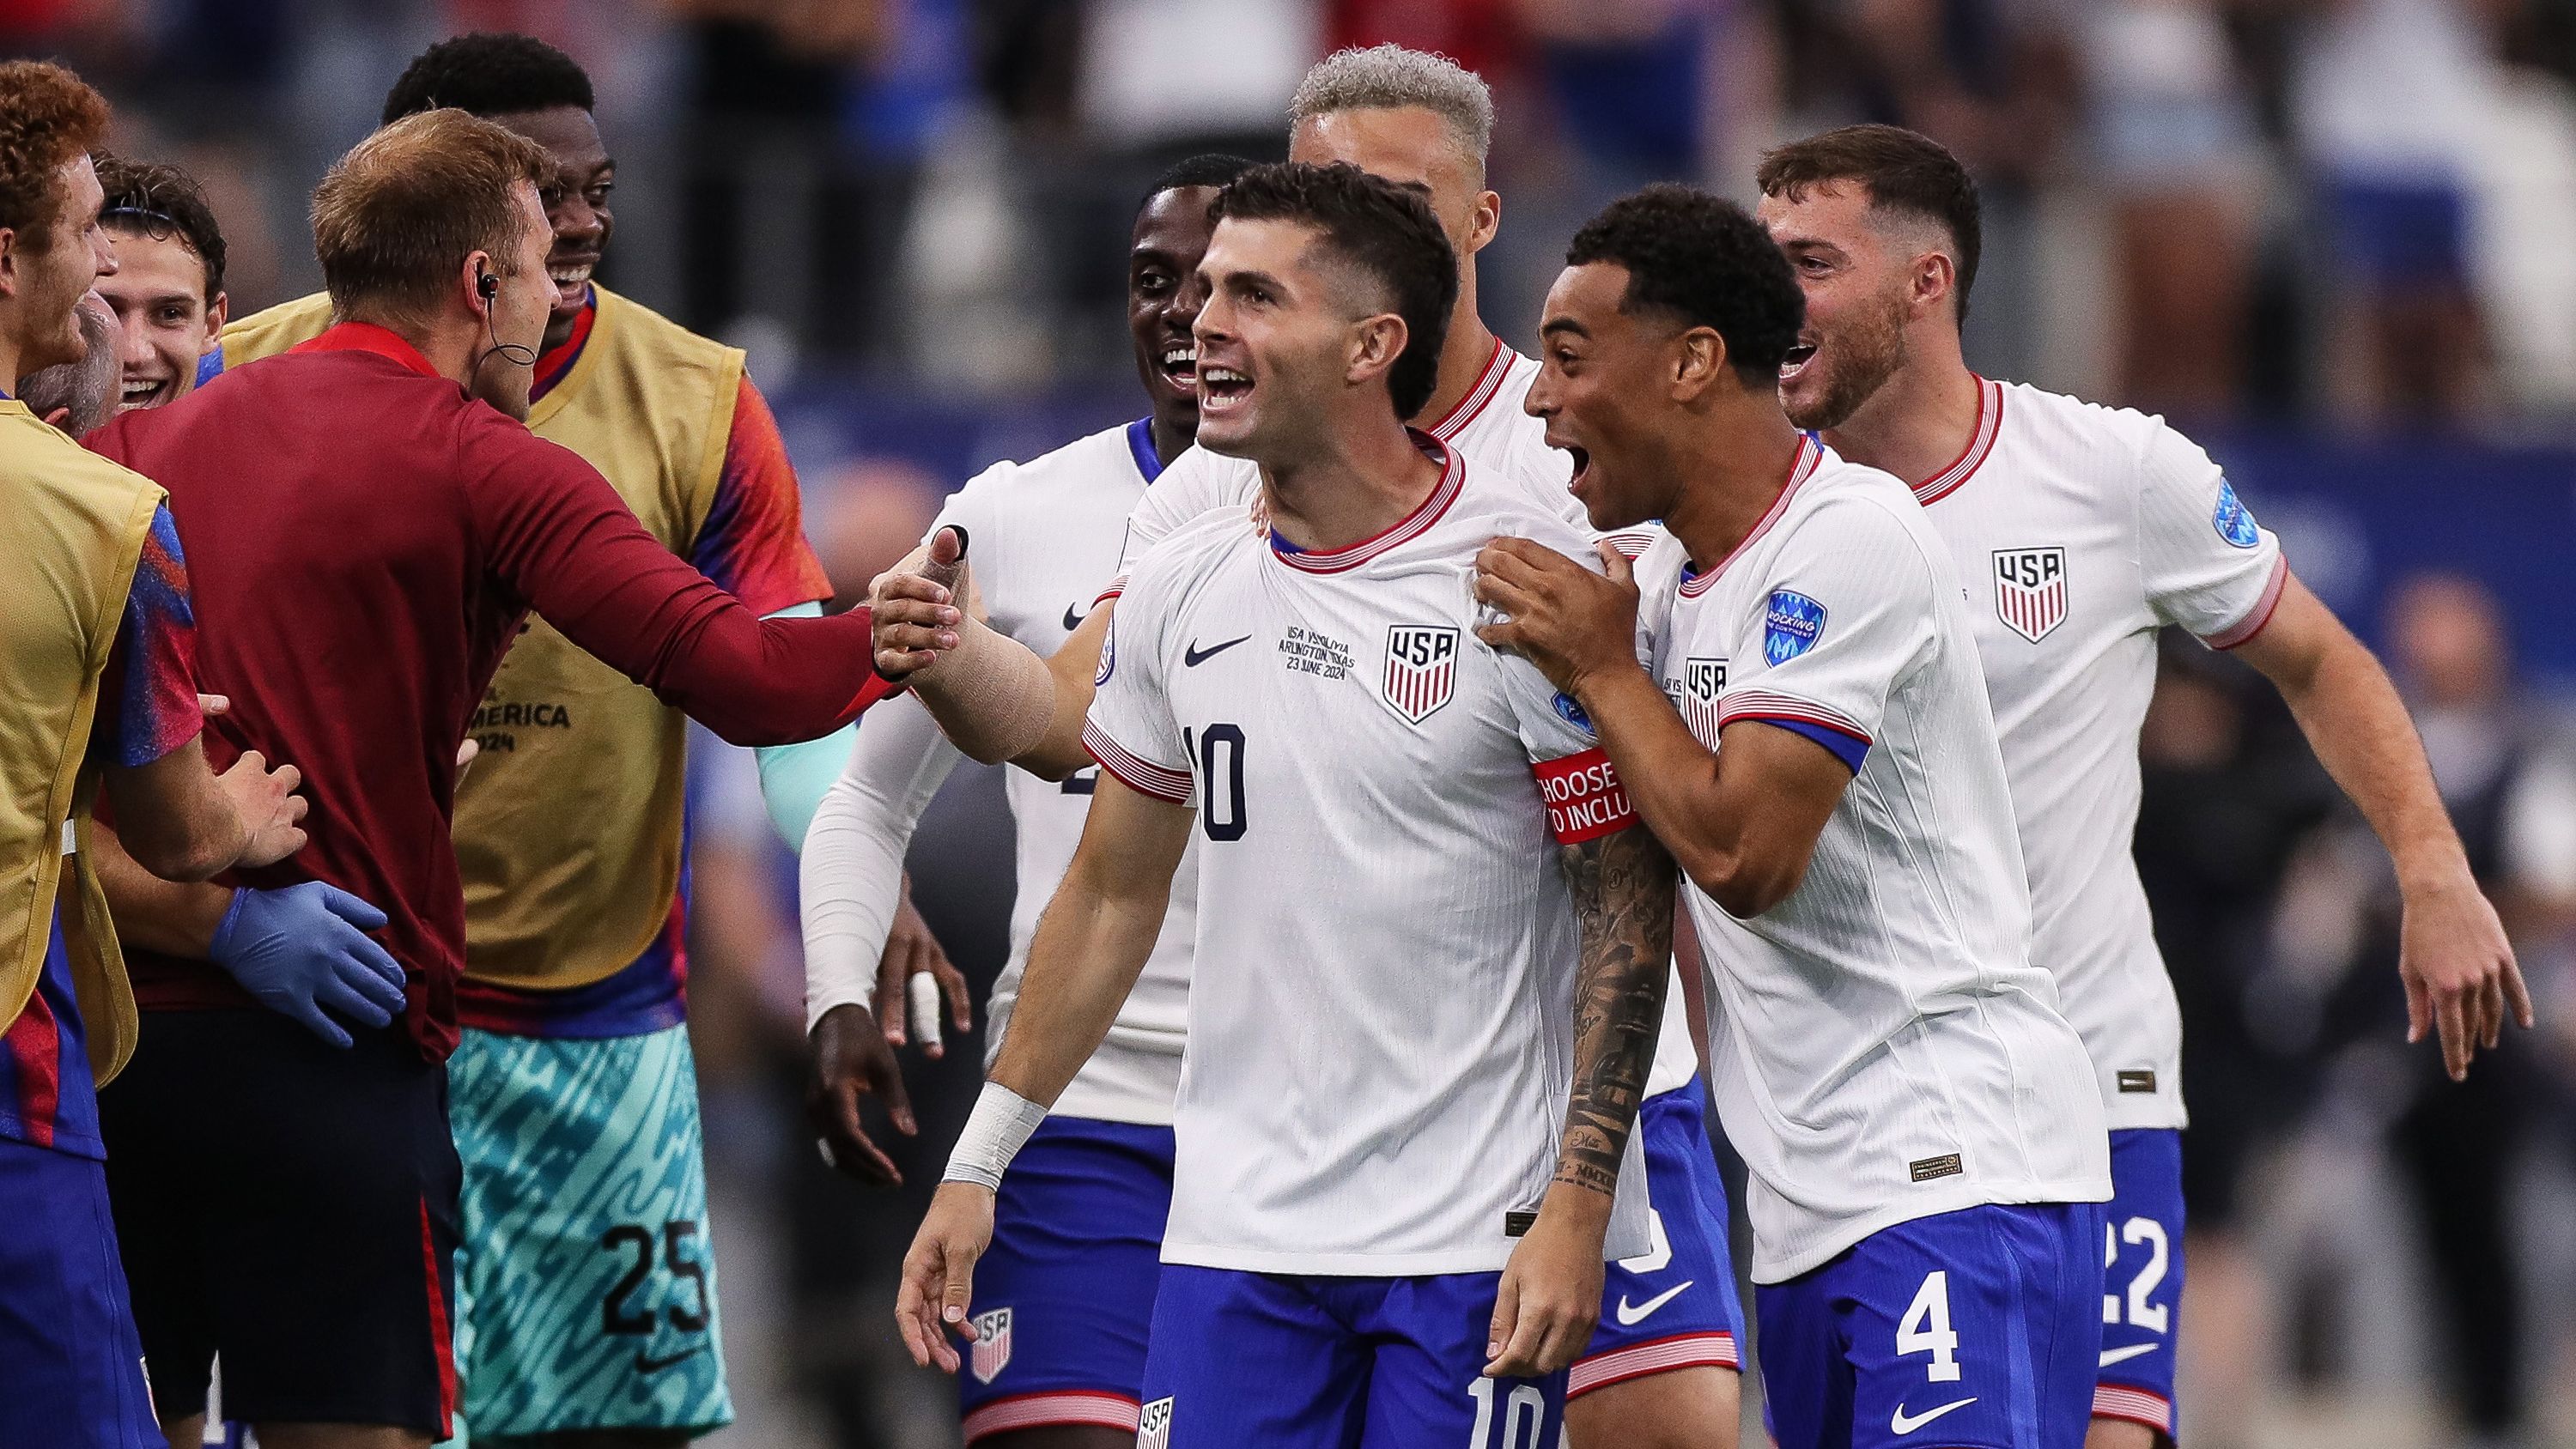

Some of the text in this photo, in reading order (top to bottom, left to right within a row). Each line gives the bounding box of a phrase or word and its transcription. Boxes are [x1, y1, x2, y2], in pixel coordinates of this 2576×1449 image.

[1999, 554, 2060, 588] USA
[1287, 626, 1304, 640] USA
[1768, 610, 1815, 632] ROCKING
[1392, 632, 1454, 666] USA
[1287, 657, 1300, 670] 23
[1323, 664, 1346, 681] 2024
[1688, 664, 1727, 701] USA
[472, 703, 571, 728] MERICA
[1537, 761, 1617, 803] HOOSE
[1566, 792, 1636, 830] INCLU
[602, 1220, 710, 1335] 25
[1896, 1270, 1961, 1382] 4
[1143, 1401, 1170, 1432] USA
[1468, 1376, 1545, 1449] 10
